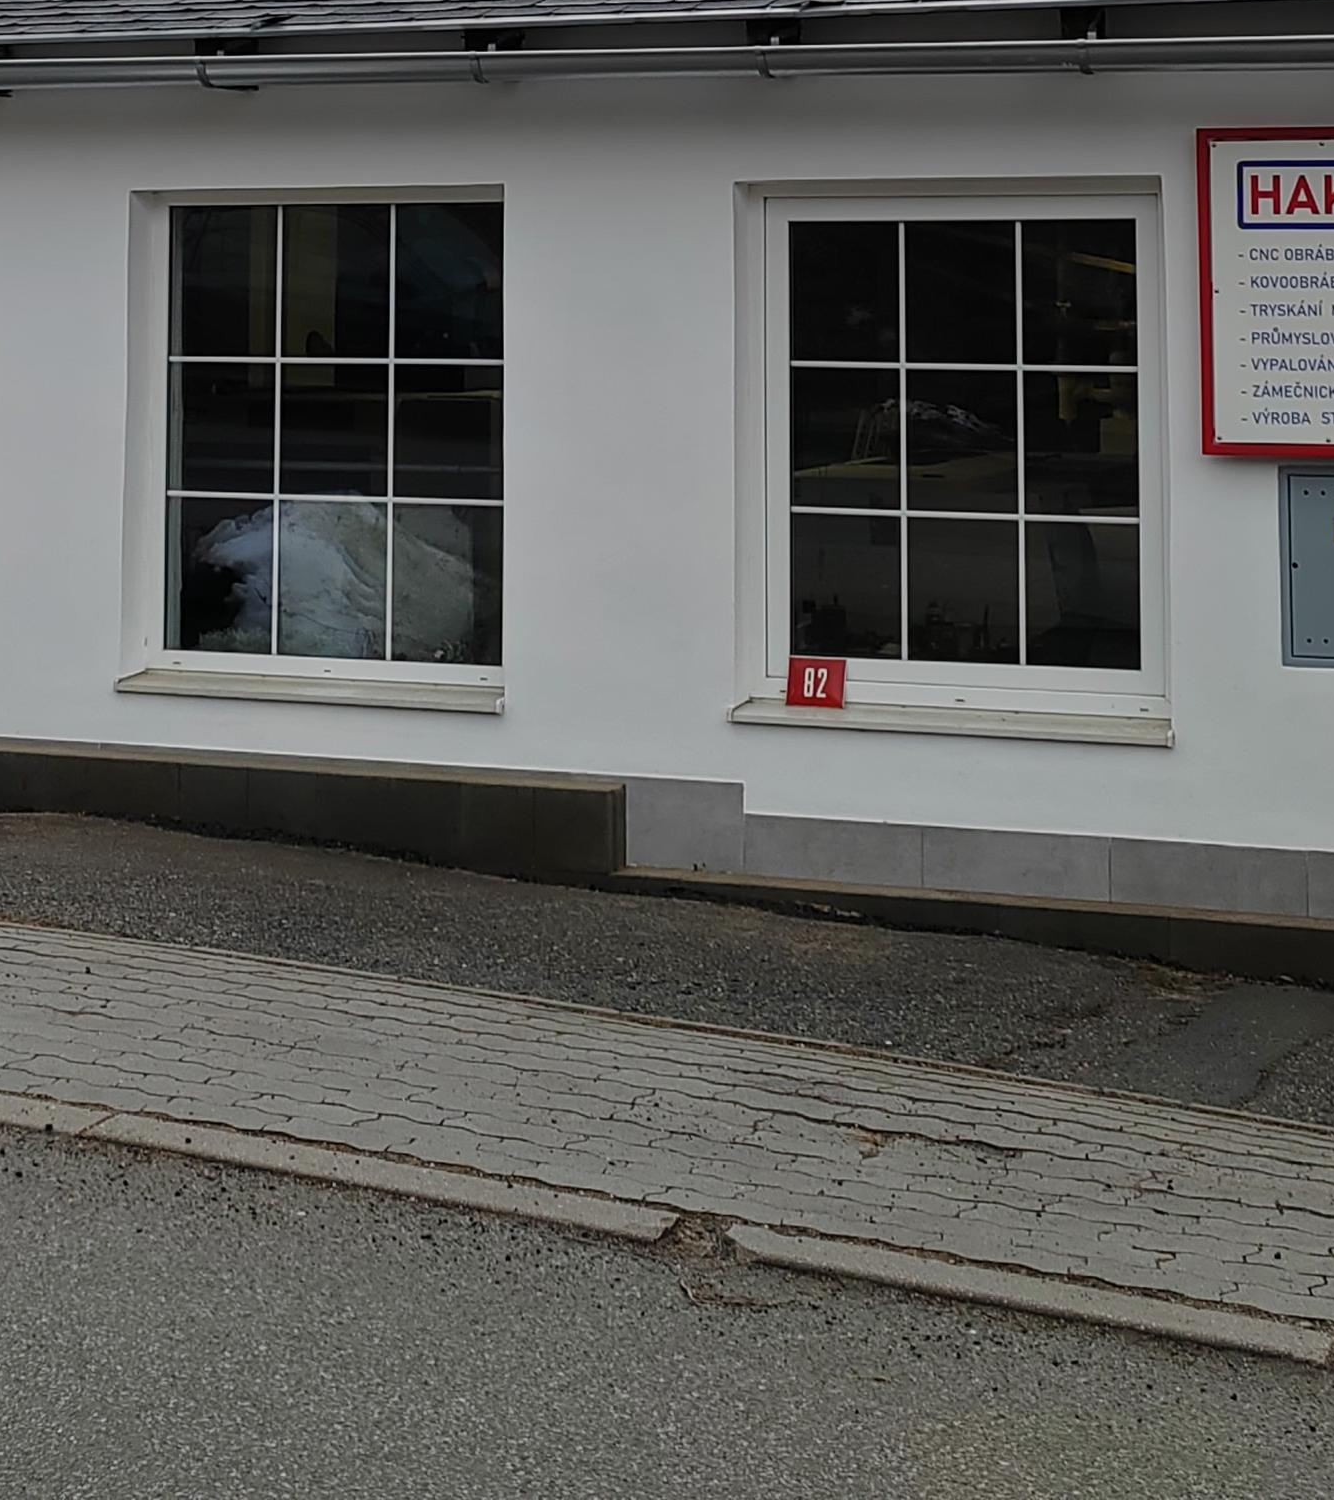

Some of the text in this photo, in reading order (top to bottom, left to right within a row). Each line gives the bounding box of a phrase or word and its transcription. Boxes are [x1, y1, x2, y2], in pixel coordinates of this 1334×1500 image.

[1249, 248, 1280, 262] CNC
[1250, 300, 1323, 318] TRYSKÁNÍ
[1252, 407, 1311, 425] VÝROBA
[804, 667, 828, 698] 82
